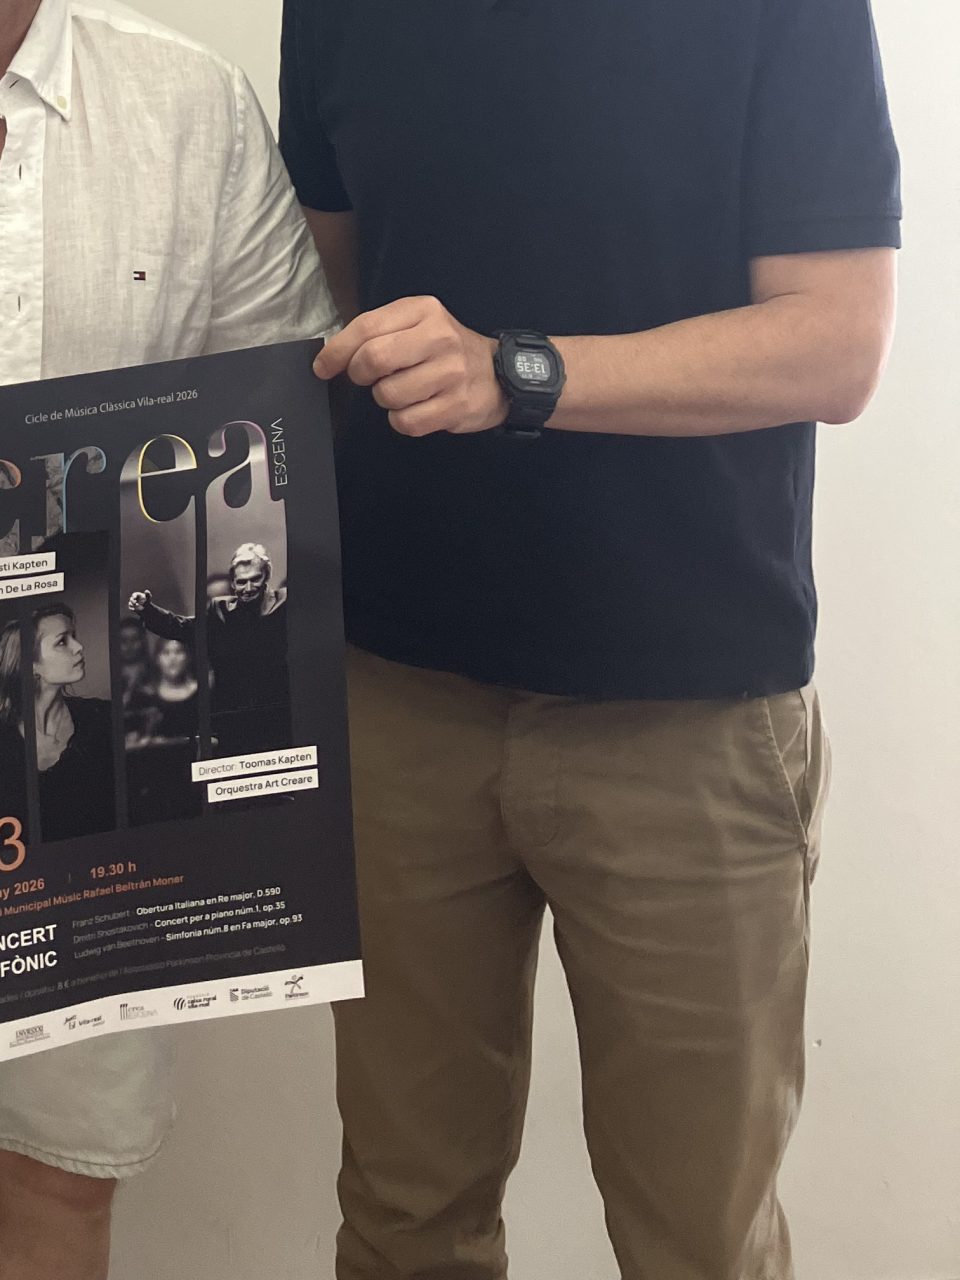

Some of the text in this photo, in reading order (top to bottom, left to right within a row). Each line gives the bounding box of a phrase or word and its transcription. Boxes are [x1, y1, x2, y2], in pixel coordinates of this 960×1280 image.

[25, 389, 198, 425] Cicle de Música Clàssica Vila-real 2026
[13, 559, 48, 572] Kapten
[6, 584, 19, 594] De
[21, 582, 32, 592] La
[35, 579, 58, 590] Rosa
[240, 757, 276, 770] Toomas
[278, 752, 312, 765] Kapten
[216, 775, 313, 796] Orquestra Art Creare
[14, 878, 45, 896] 2026
[90, 863, 125, 879] 19.30
[128, 861, 137, 873] h
[5, 899, 52, 918] Municipal
[53, 892, 81, 909] Músic
[84, 886, 114, 899] Rafael
[116, 878, 151, 893] Beltrán
[153, 874, 184, 888] Moner
[136, 904, 174, 917] Obertura
[175, 899, 205, 911] Italiana
[207, 896, 217, 906] en
[219, 894, 229, 903] Re
[257, 886, 281, 898] D.590
[155, 915, 189, 928] Concert
[190, 913, 204, 924] per
[205, 912, 211, 921] a
[212, 908, 235, 921] piano
[263, 901, 286, 915] op.35
[166, 928, 202, 942] Simfonia
[204, 924, 229, 936] núm.8
[230, 923, 241, 932] en
[242, 921, 252, 930] Fa
[280, 914, 303, 927] op.93
